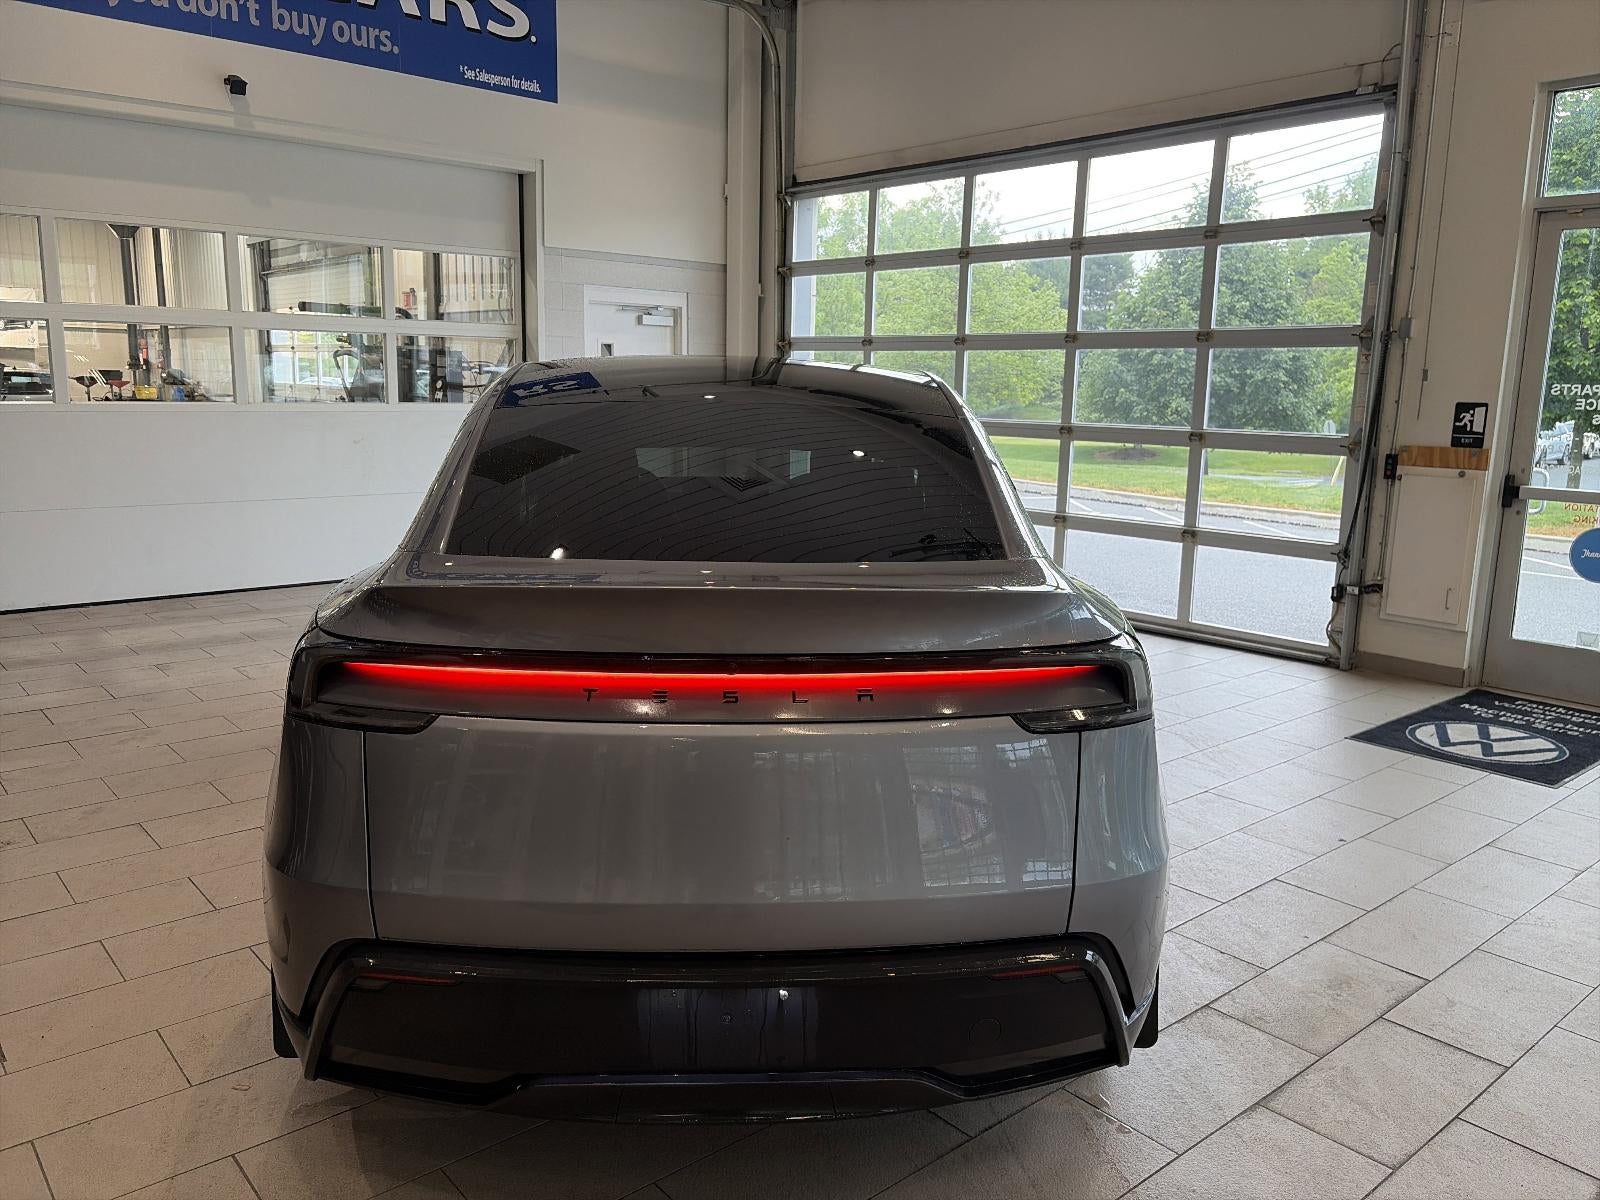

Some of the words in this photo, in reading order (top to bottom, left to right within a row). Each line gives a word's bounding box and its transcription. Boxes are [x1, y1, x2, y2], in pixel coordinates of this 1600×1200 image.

[271, 0, 327, 46] buy
[332, 20, 400, 54] ours.
[476, 68, 511, 87] Salesperson
[511, 75, 520, 89] for
[521, 78, 542, 93] details.
[582, 687, 875, 704] TESLA
[1460, 703, 1600, 736] Mechanicsbur
